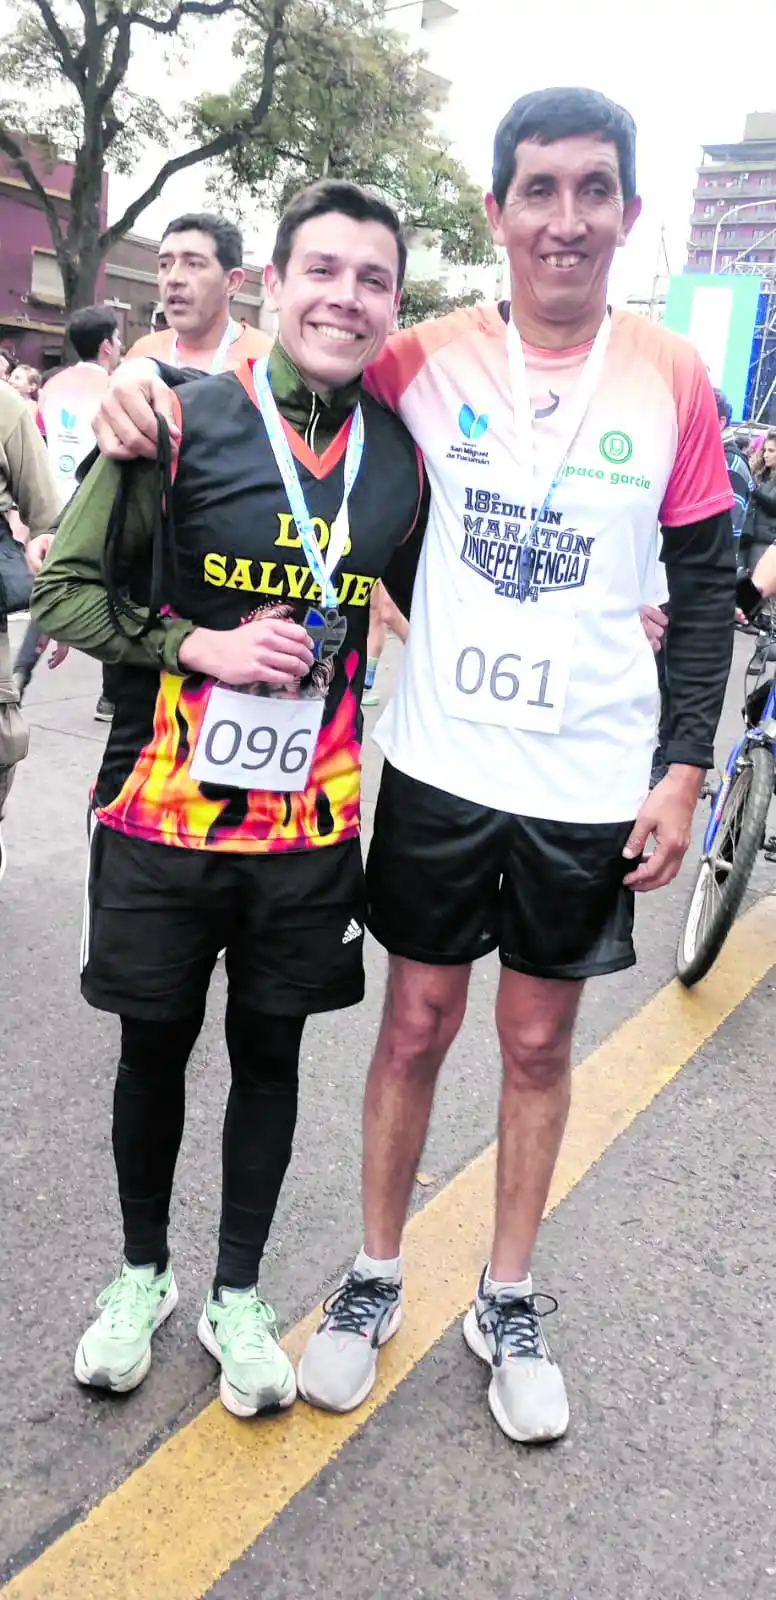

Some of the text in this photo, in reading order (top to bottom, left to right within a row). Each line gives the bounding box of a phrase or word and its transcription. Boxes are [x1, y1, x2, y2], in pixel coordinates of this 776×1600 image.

[565, 465, 604, 478] paco
[455, 646, 554, 708] 061
[205, 719, 311, 774] 096
